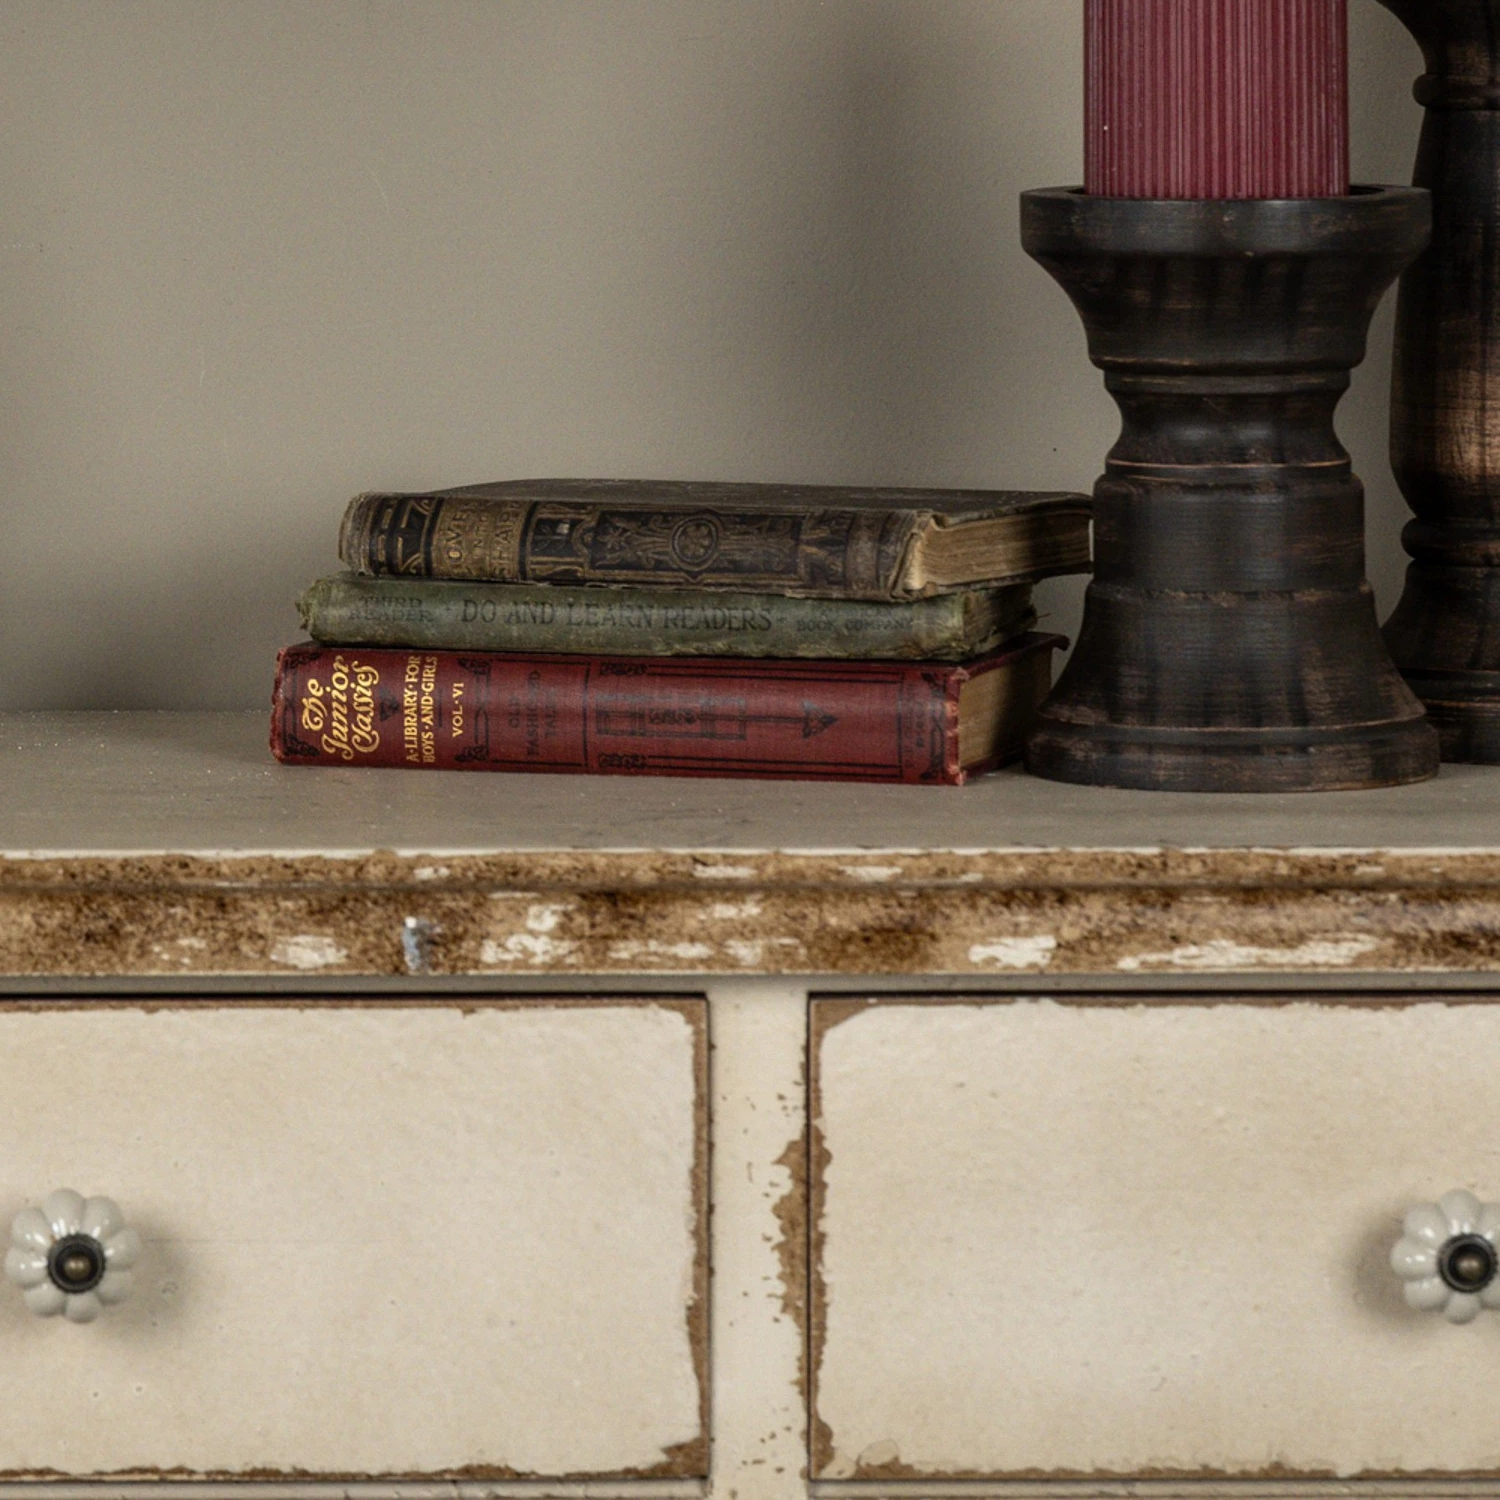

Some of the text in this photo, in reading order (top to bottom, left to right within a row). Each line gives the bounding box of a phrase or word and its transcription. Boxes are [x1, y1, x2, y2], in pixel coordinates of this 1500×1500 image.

[461, 599, 773, 631] DO AND LEARN READERS
[301, 678, 327, 731] The
[320, 655, 355, 760] Junior
[350, 660, 379, 752] Classics
